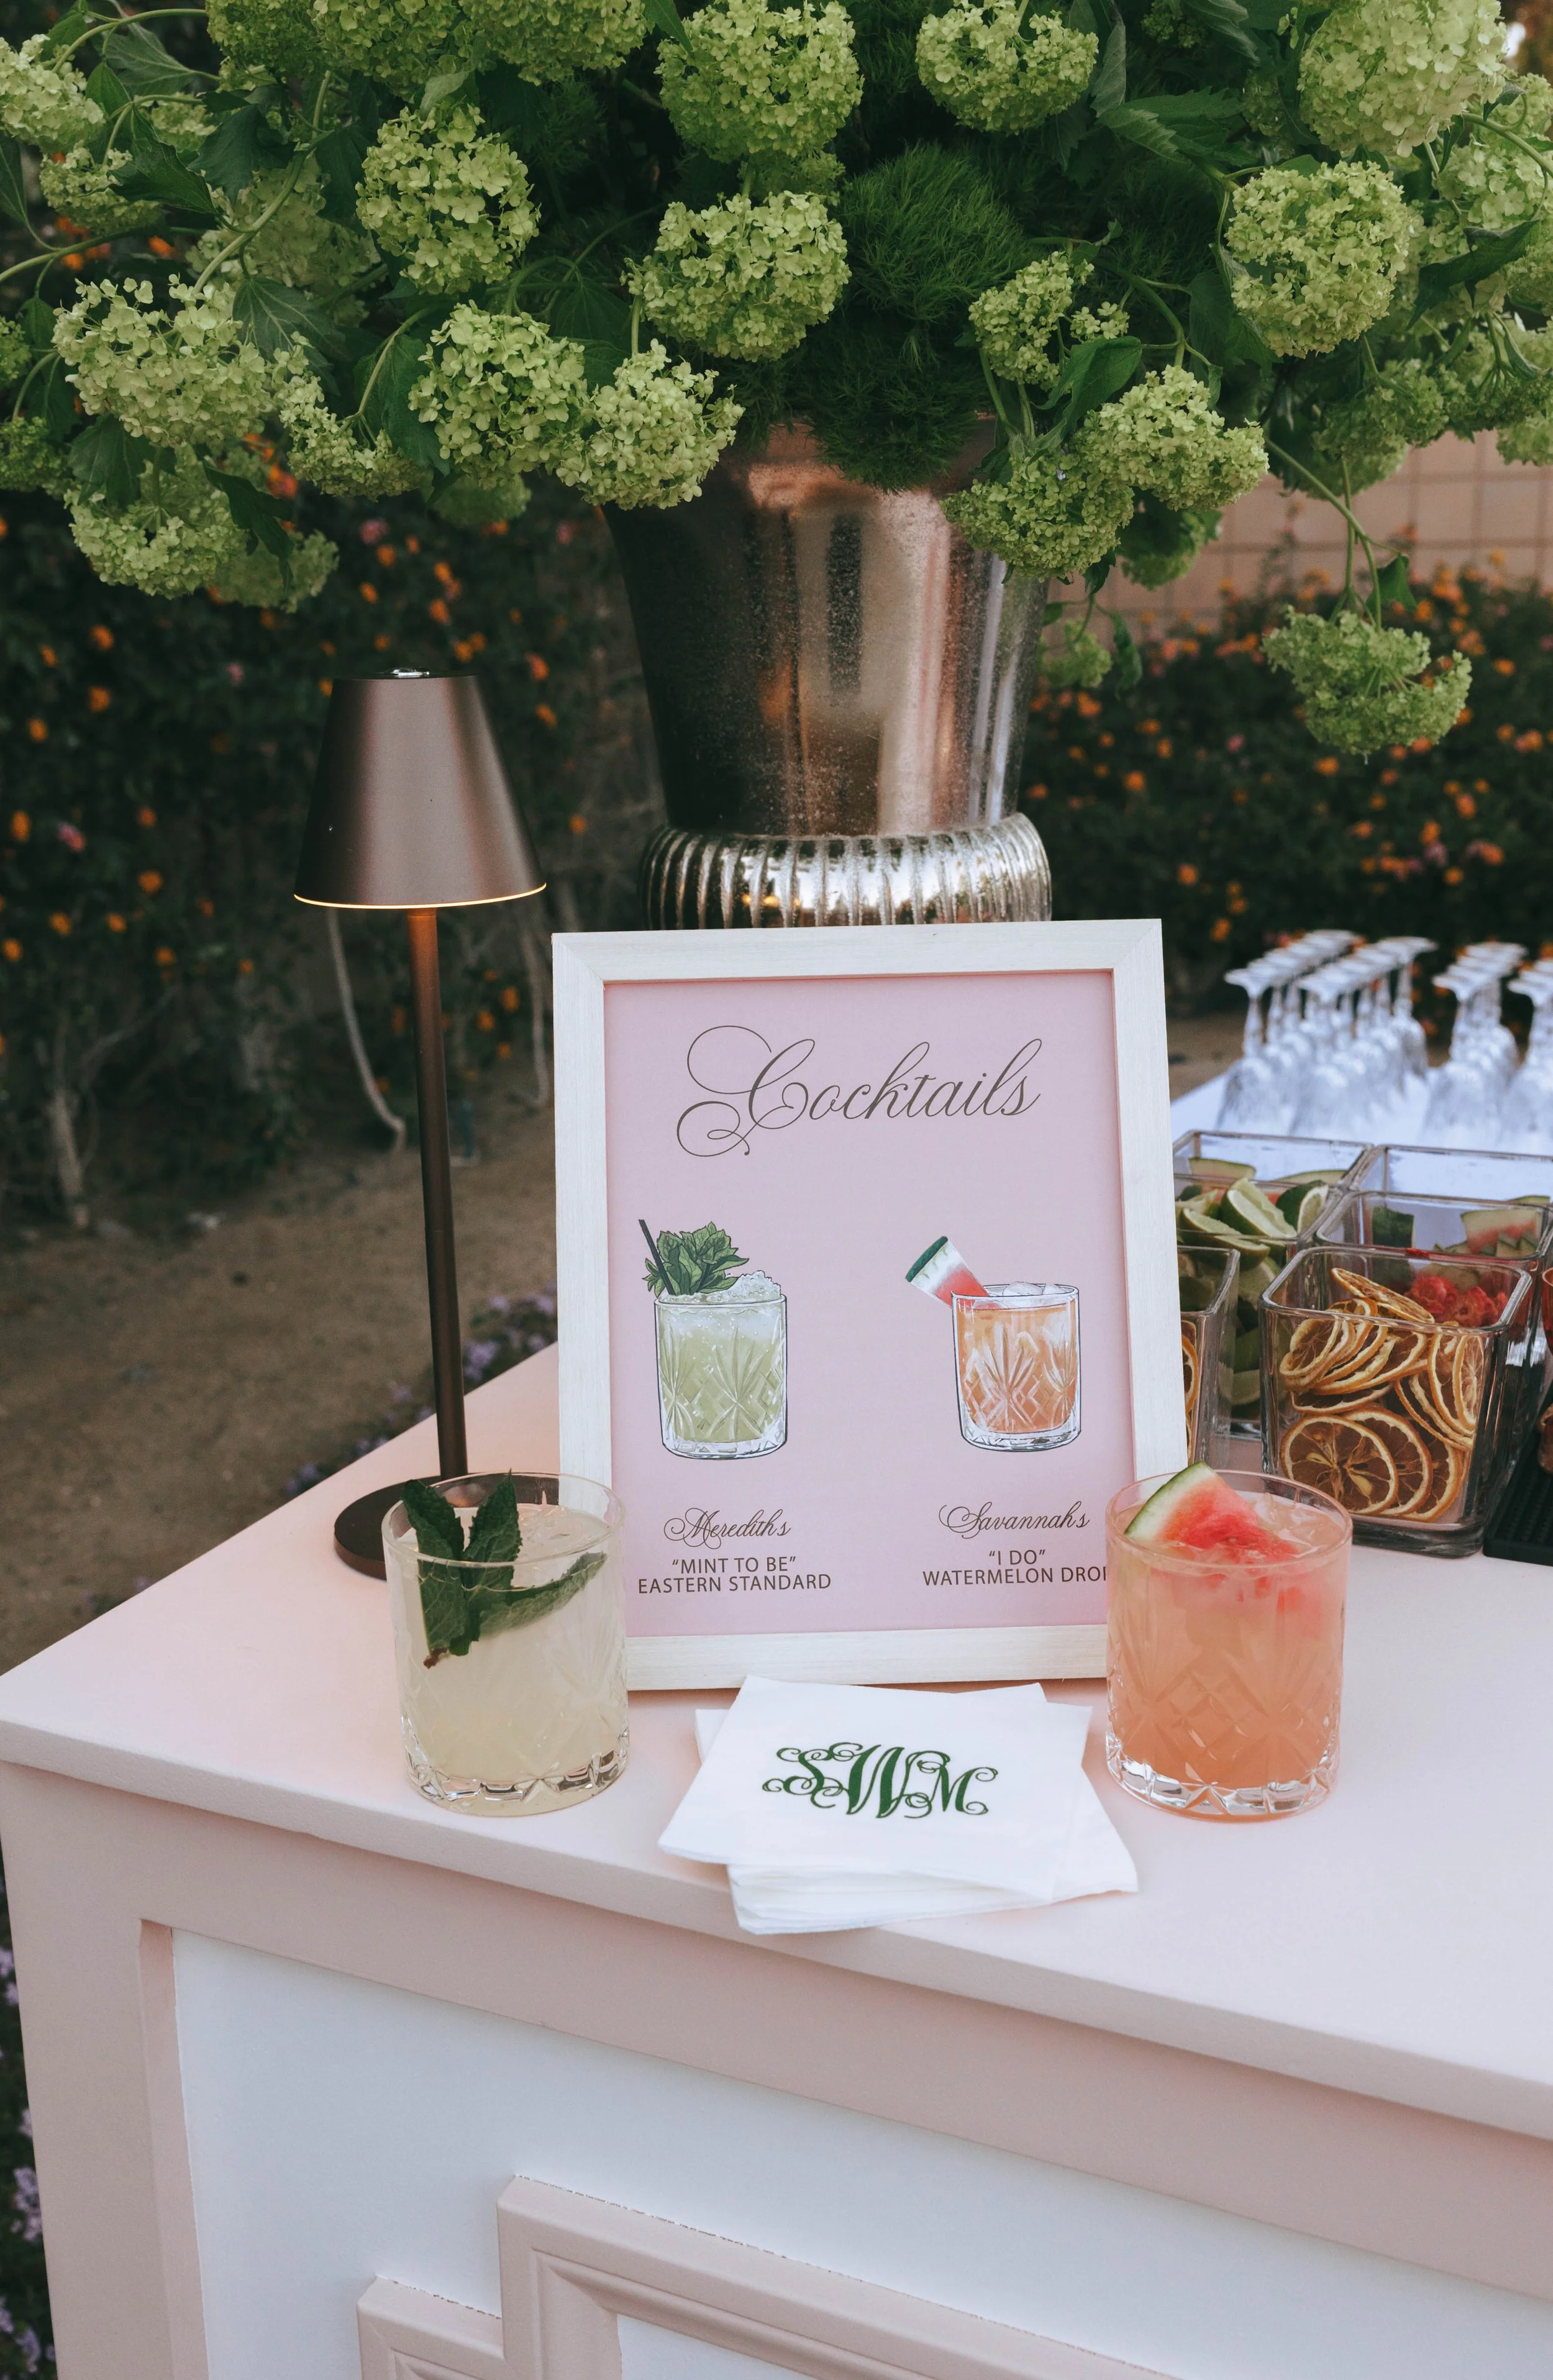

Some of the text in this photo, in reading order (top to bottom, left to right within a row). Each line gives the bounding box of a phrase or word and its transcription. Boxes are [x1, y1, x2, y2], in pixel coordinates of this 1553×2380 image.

[676, 1025, 1042, 1157] Cocktails
[672, 1556, 796, 1574] “MINT TO BE”
[1009, 1549, 1045, 1566] DO”
[638, 1574, 831, 1594] EASTERN STANDARD
[922, 1567, 1054, 1586] WATERMELON
